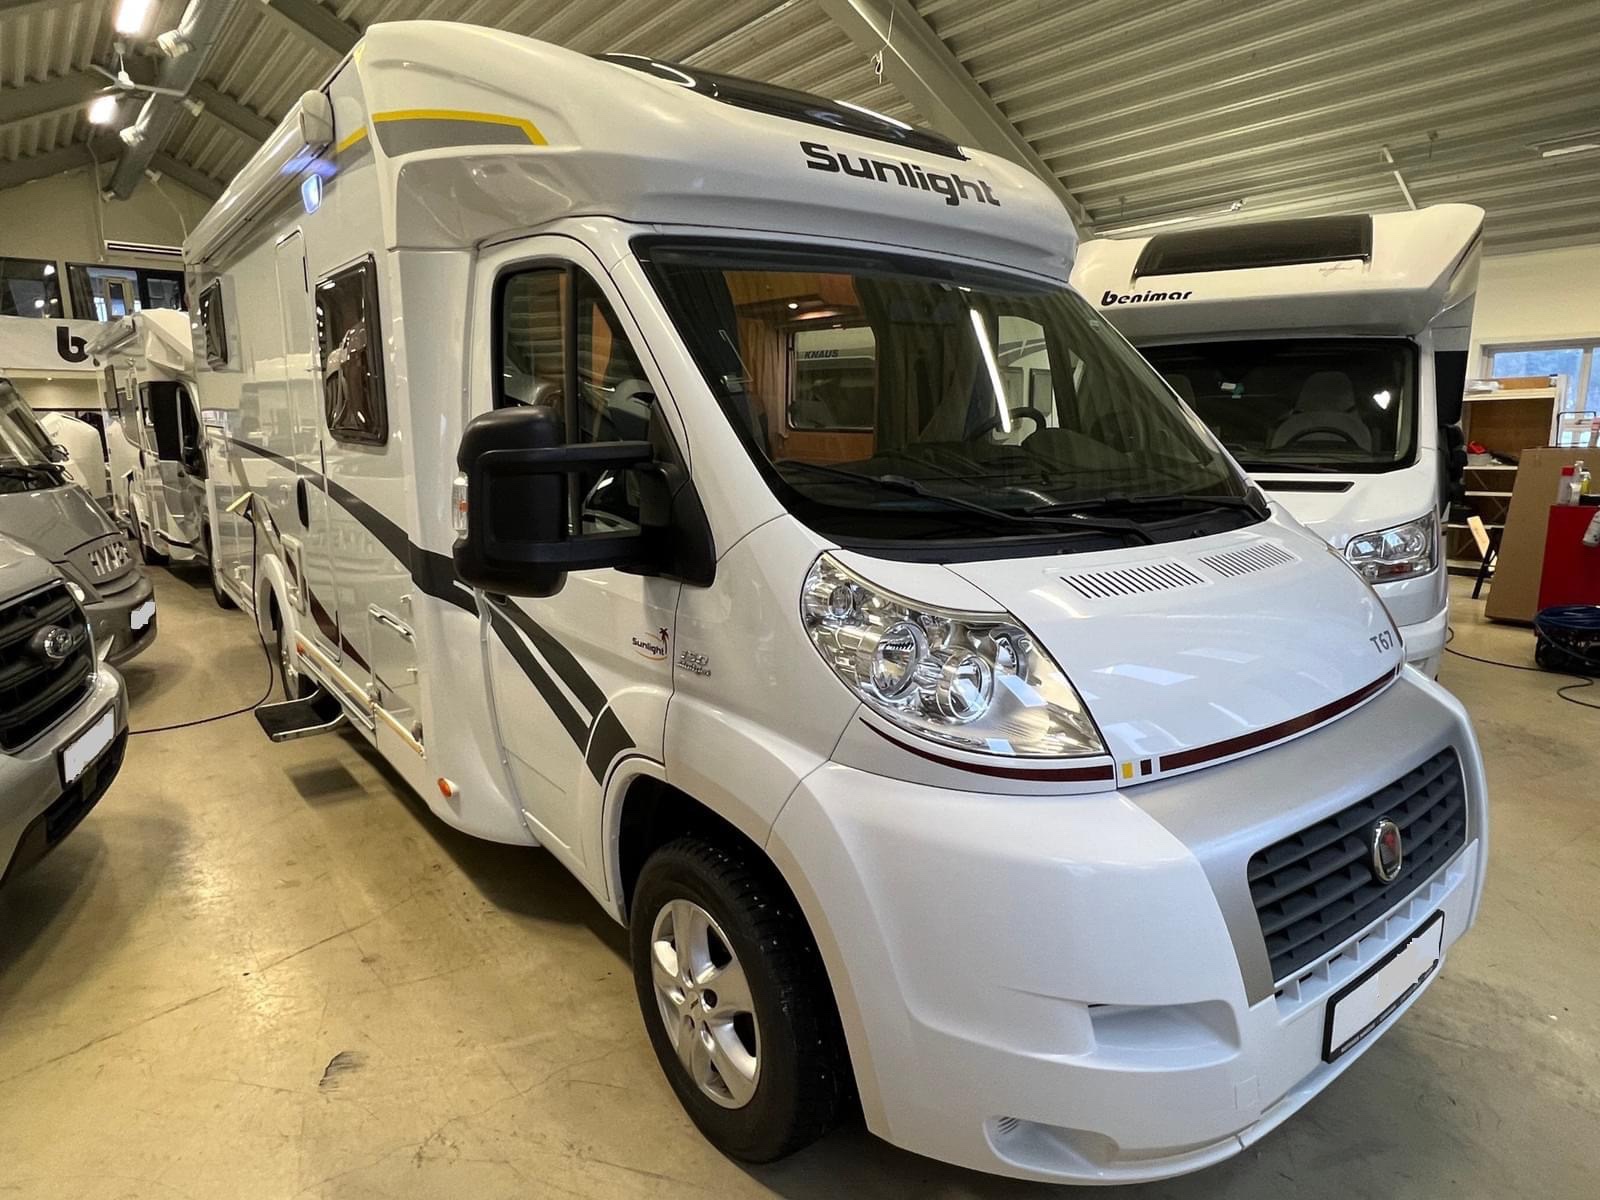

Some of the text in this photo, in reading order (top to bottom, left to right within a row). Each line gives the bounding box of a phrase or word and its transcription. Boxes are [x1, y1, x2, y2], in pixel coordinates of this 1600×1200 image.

[799, 141, 1001, 207] Sunlight
[1101, 290, 1192, 306] benimar
[803, 349, 840, 359] KNAUS
[632, 636, 665, 656] Sunlight
[1369, 630, 1394, 653] T67
